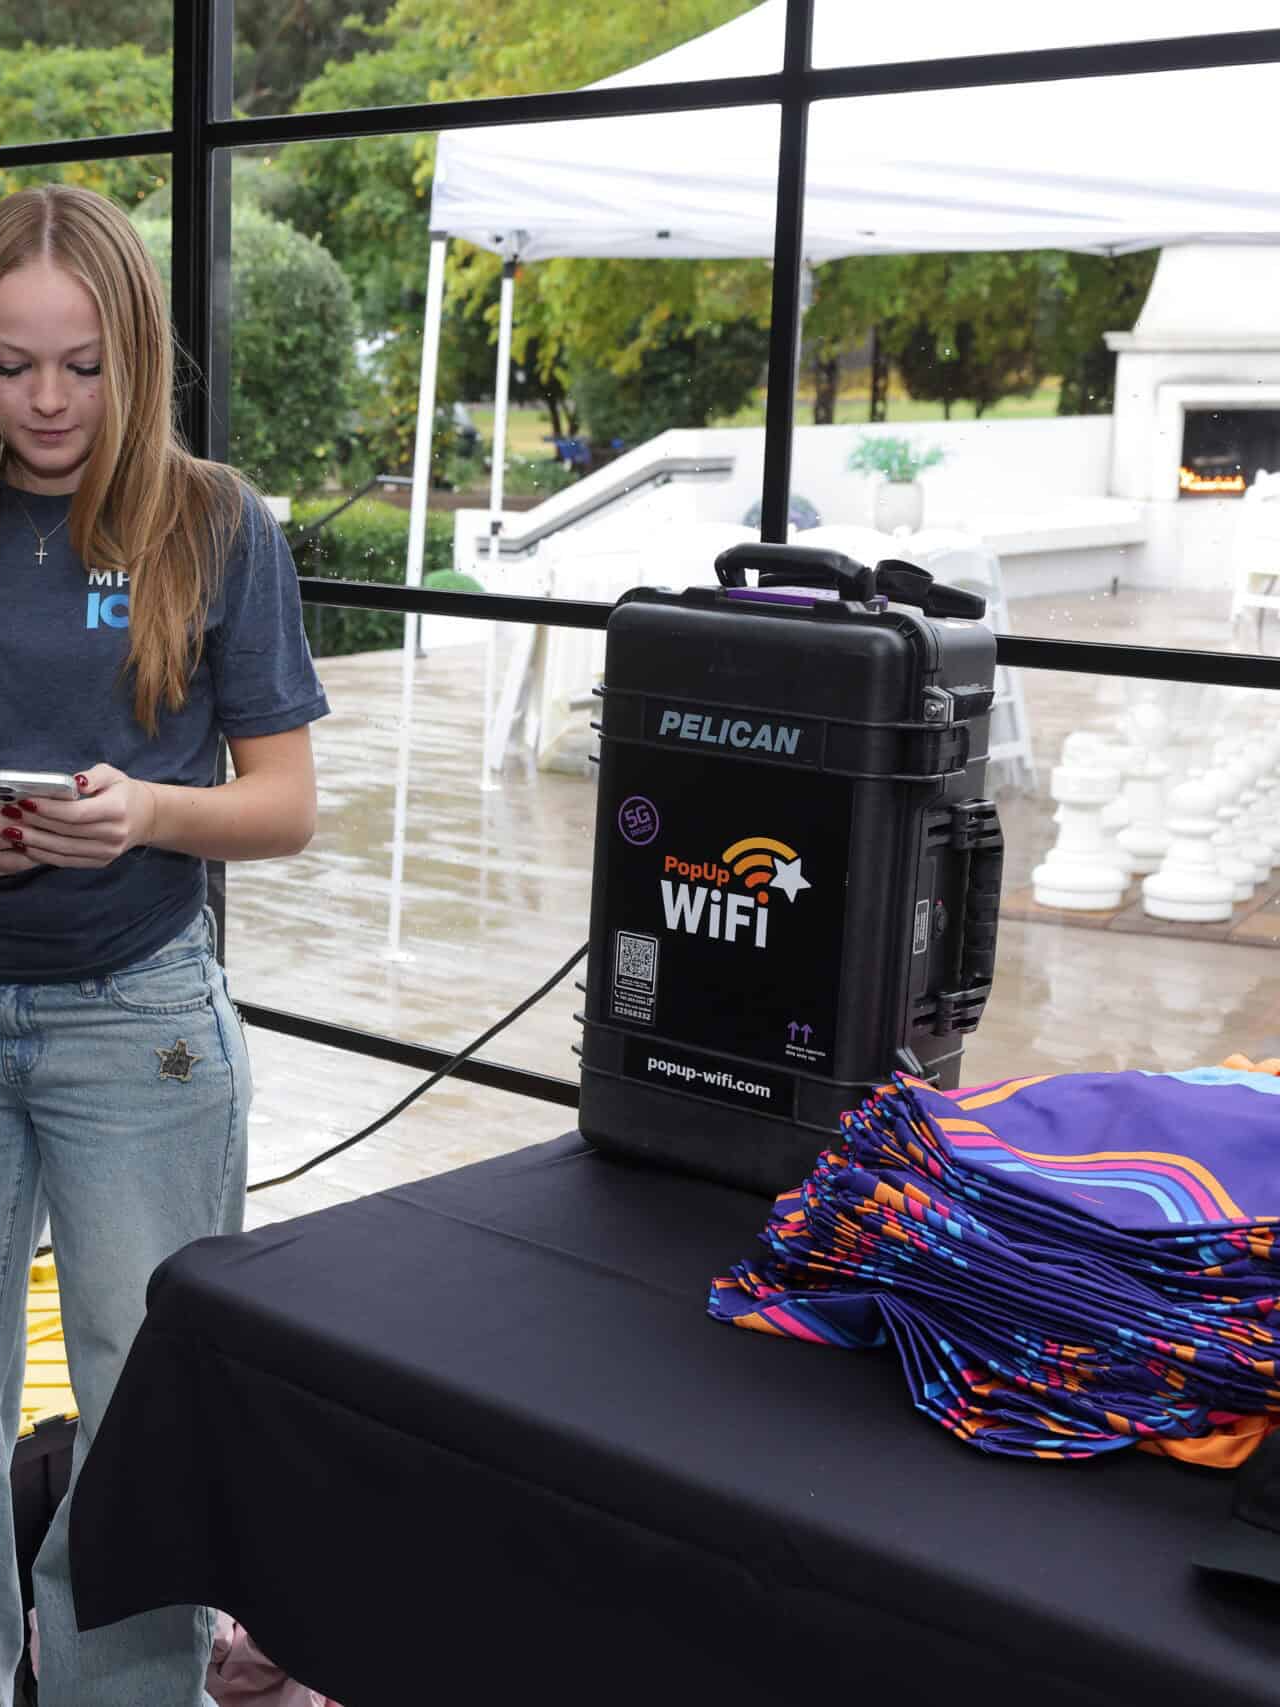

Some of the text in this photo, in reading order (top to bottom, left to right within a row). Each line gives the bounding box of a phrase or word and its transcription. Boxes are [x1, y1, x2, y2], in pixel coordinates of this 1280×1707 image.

[88, 568, 130, 587] MP
[87, 592, 129, 629] 10
[658, 710, 801, 754] PELICAN
[623, 803, 651, 829] 5G
[664, 855, 730, 886] PopUp
[660, 879, 769, 949] WiFi
[647, 1057, 771, 1099] popup-wifi.com
